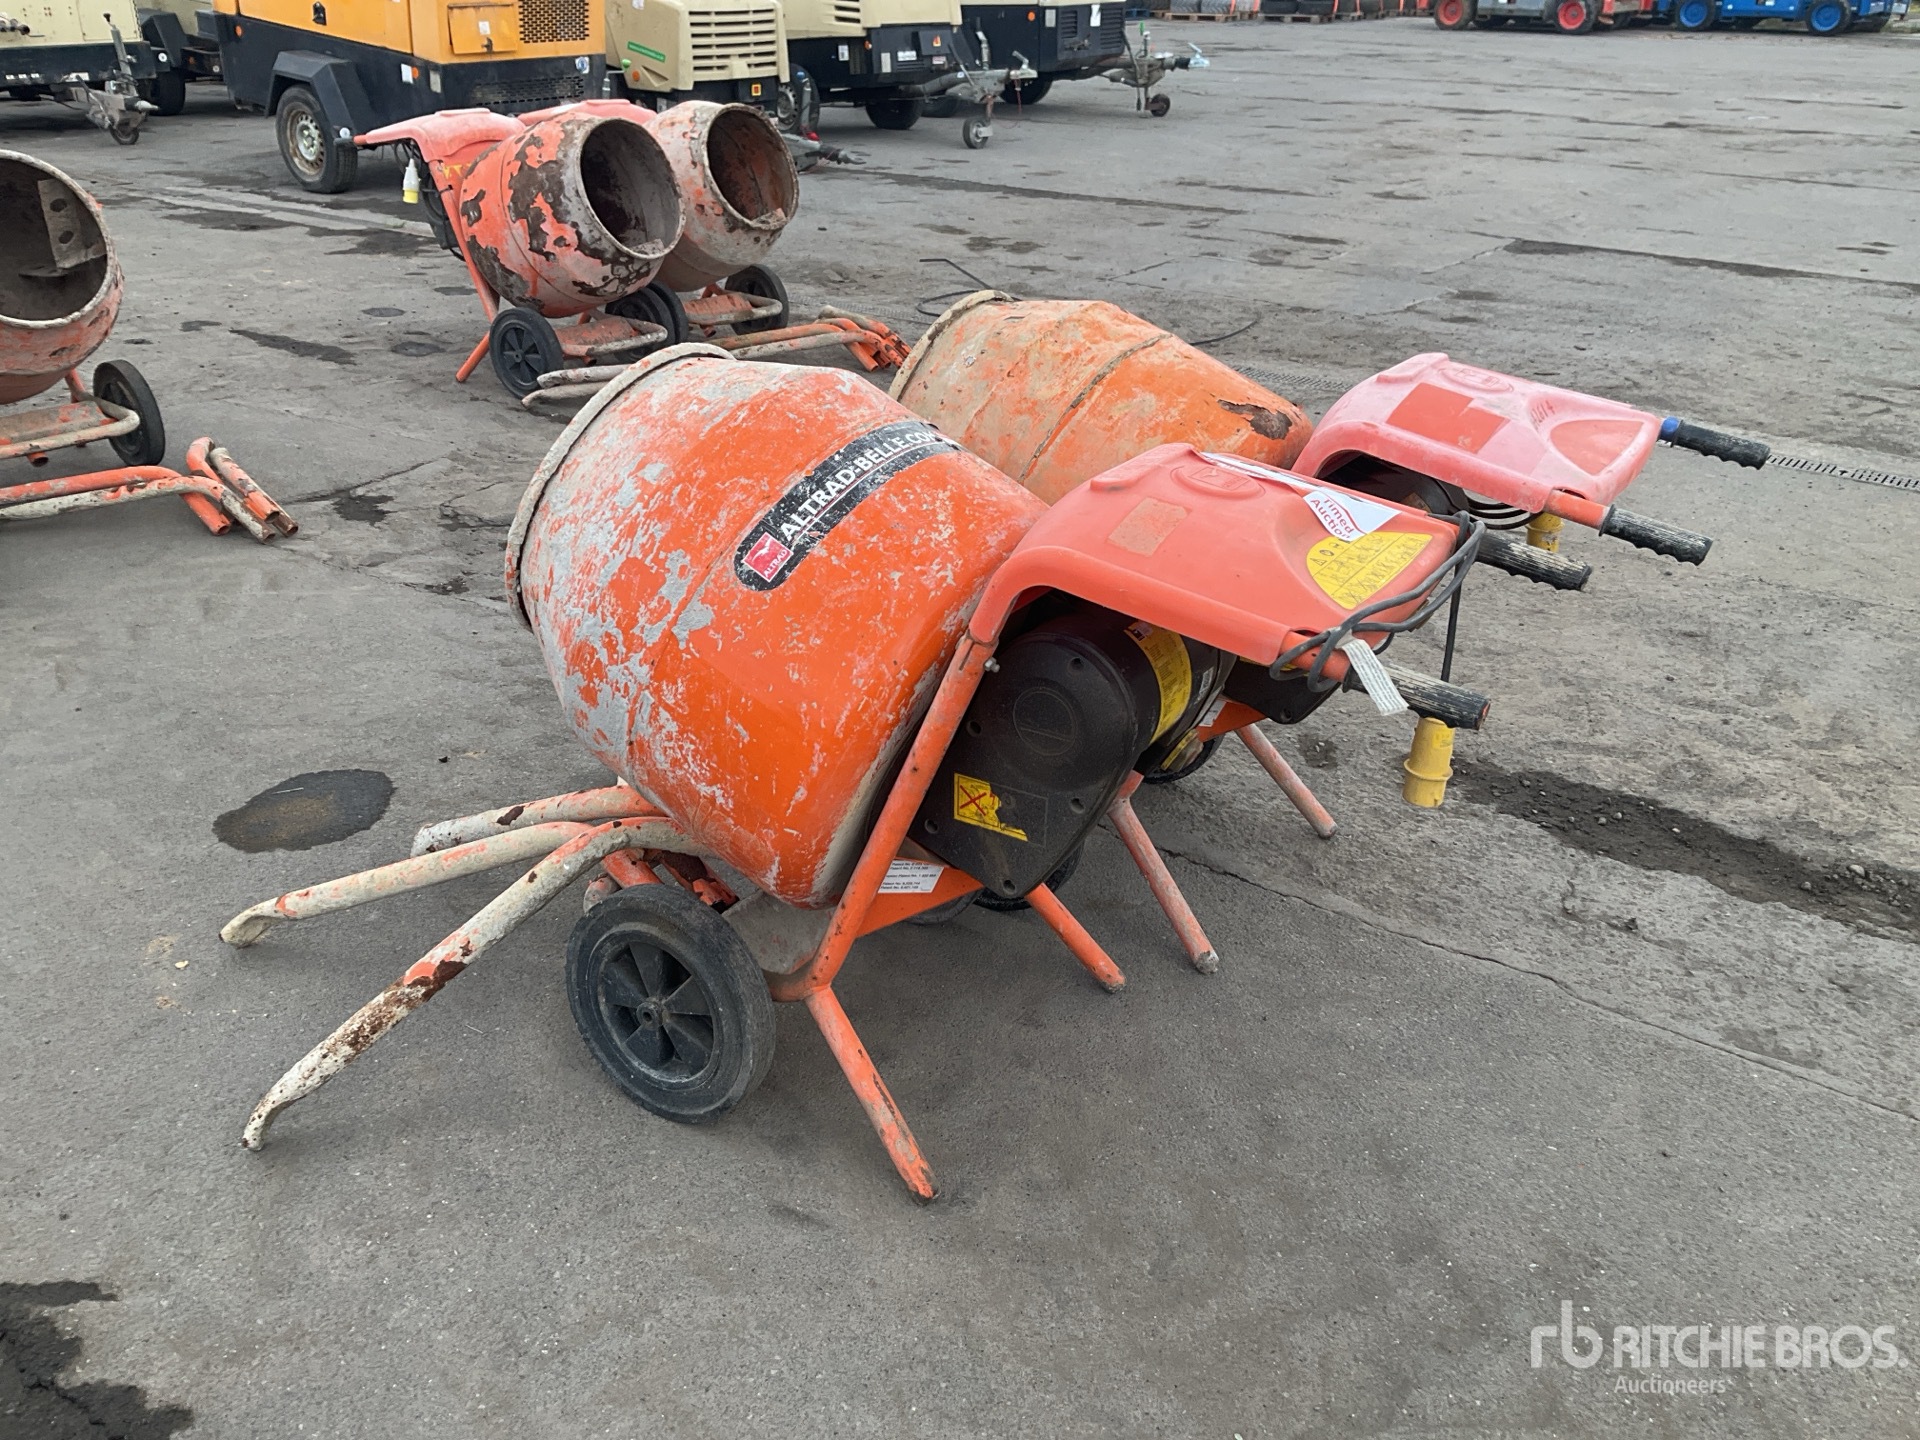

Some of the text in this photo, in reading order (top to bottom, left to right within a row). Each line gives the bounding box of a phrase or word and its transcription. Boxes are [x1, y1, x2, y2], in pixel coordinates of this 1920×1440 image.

[1310, 498, 1351, 539] Auction
[1323, 497, 1355, 534] Timed
[764, 549, 788, 577] ALTRAD
